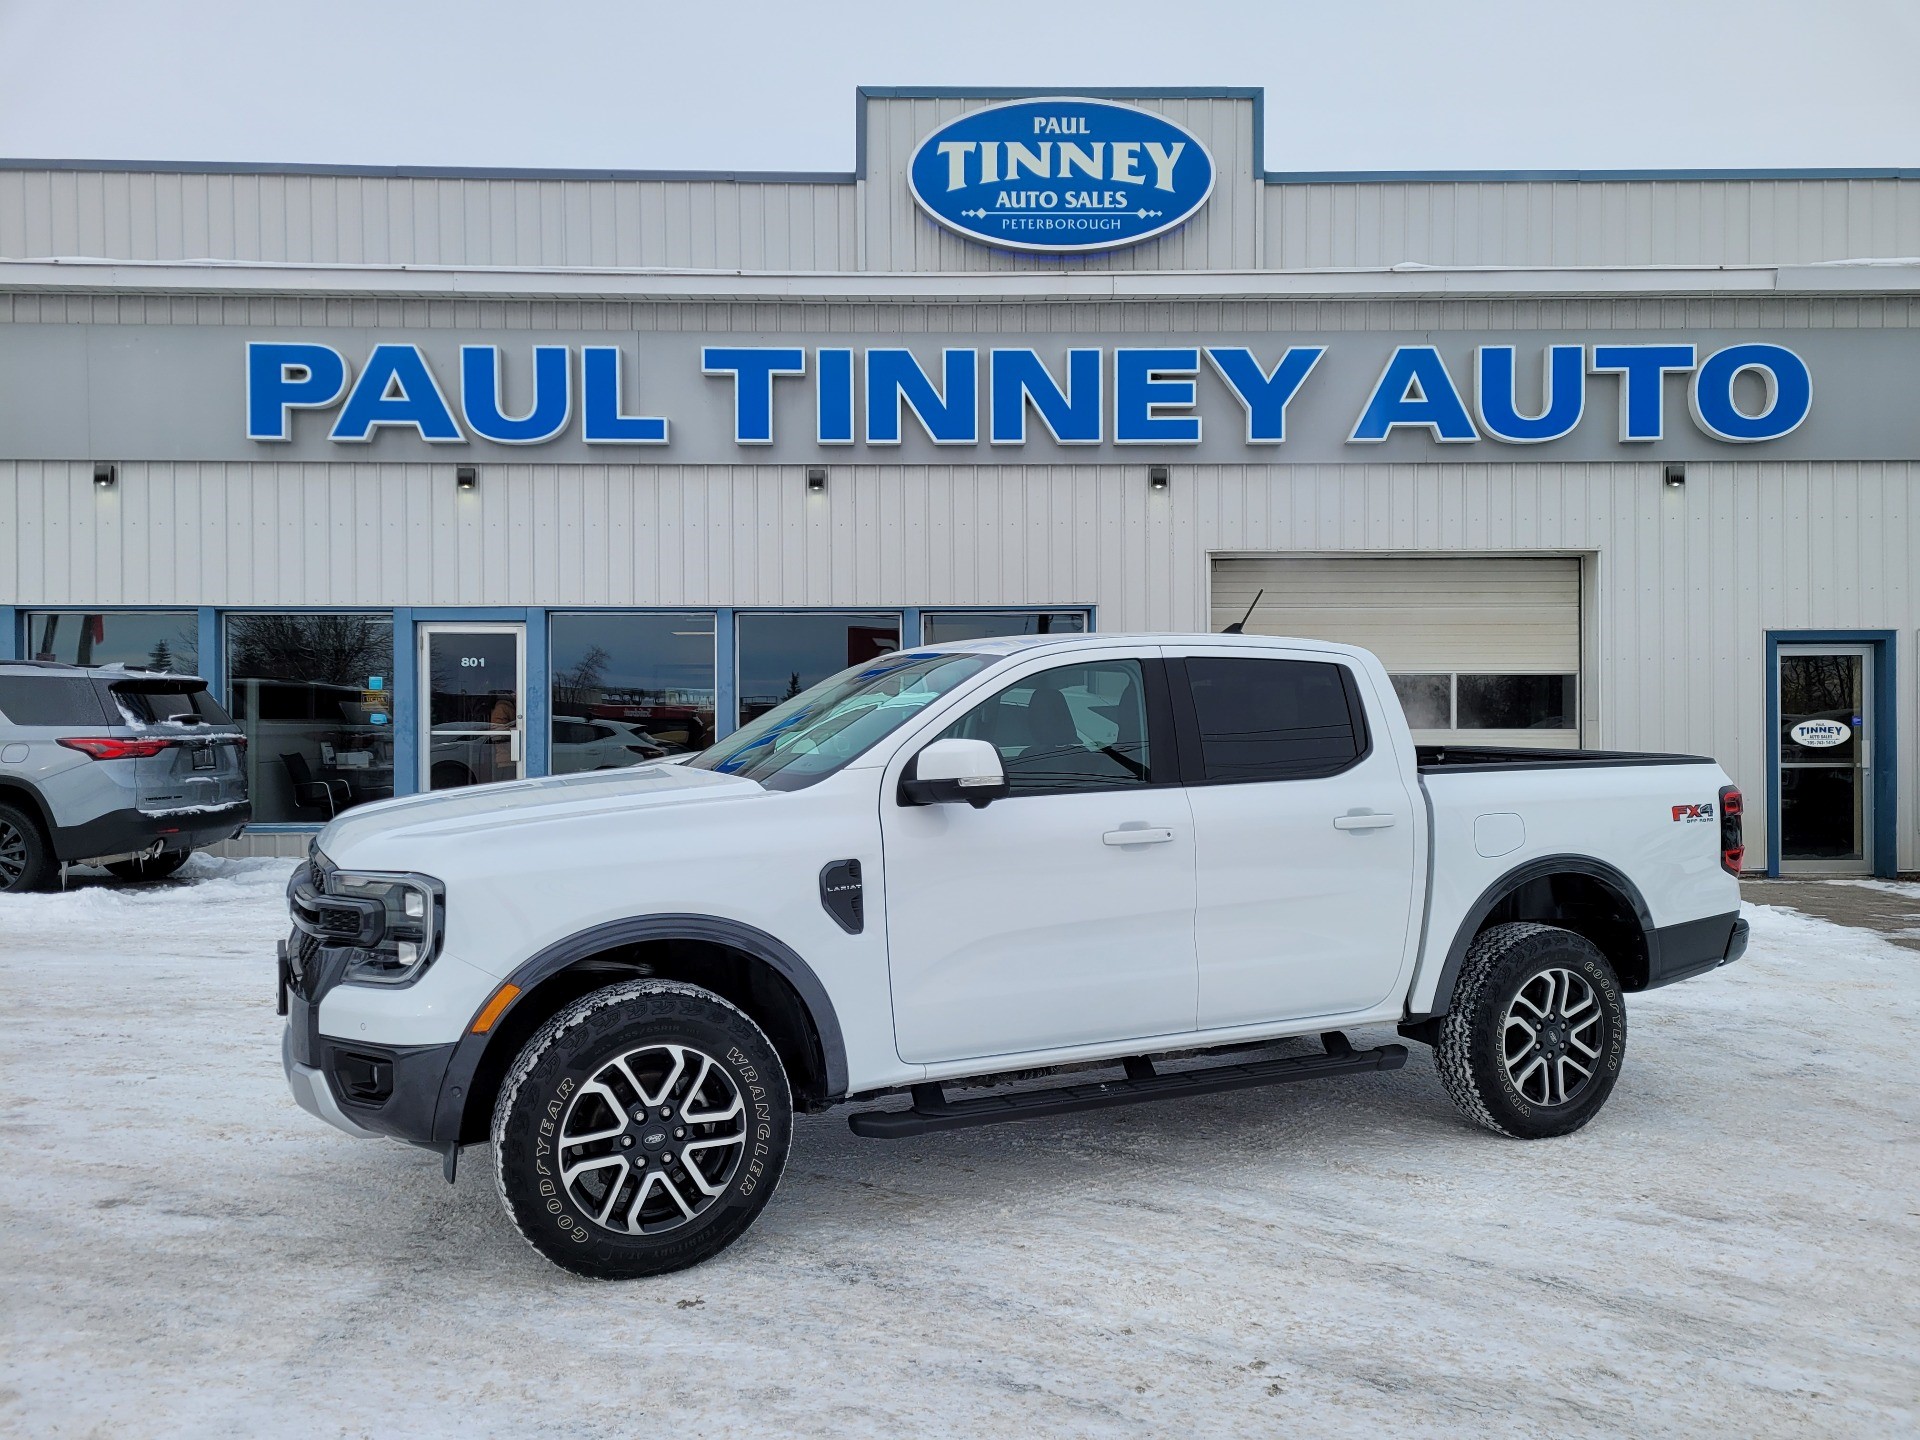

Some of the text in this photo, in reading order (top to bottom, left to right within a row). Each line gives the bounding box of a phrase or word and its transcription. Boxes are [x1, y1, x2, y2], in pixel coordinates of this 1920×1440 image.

[1033, 117, 1090, 134] PAUL
[936, 141, 1186, 193] TINNEY
[995, 190, 1128, 208] AUTO SALES
[1002, 218, 1121, 230] PETERBOROUGH
[246, 341, 1813, 446] PAUL TINNEY AUTO
[460, 657, 485, 668] 801
[1798, 726, 1842, 737] TINNEY
[1672, 803, 1713, 822] FX4
[826, 884, 862, 892] LARIAT
[1584, 961, 1622, 1072] GOODYEAR
[1494, 1010, 1532, 1119] WRANGLER
[726, 1046, 771, 1197] WRANGLER
[536, 1077, 589, 1244] GOODYEAR
